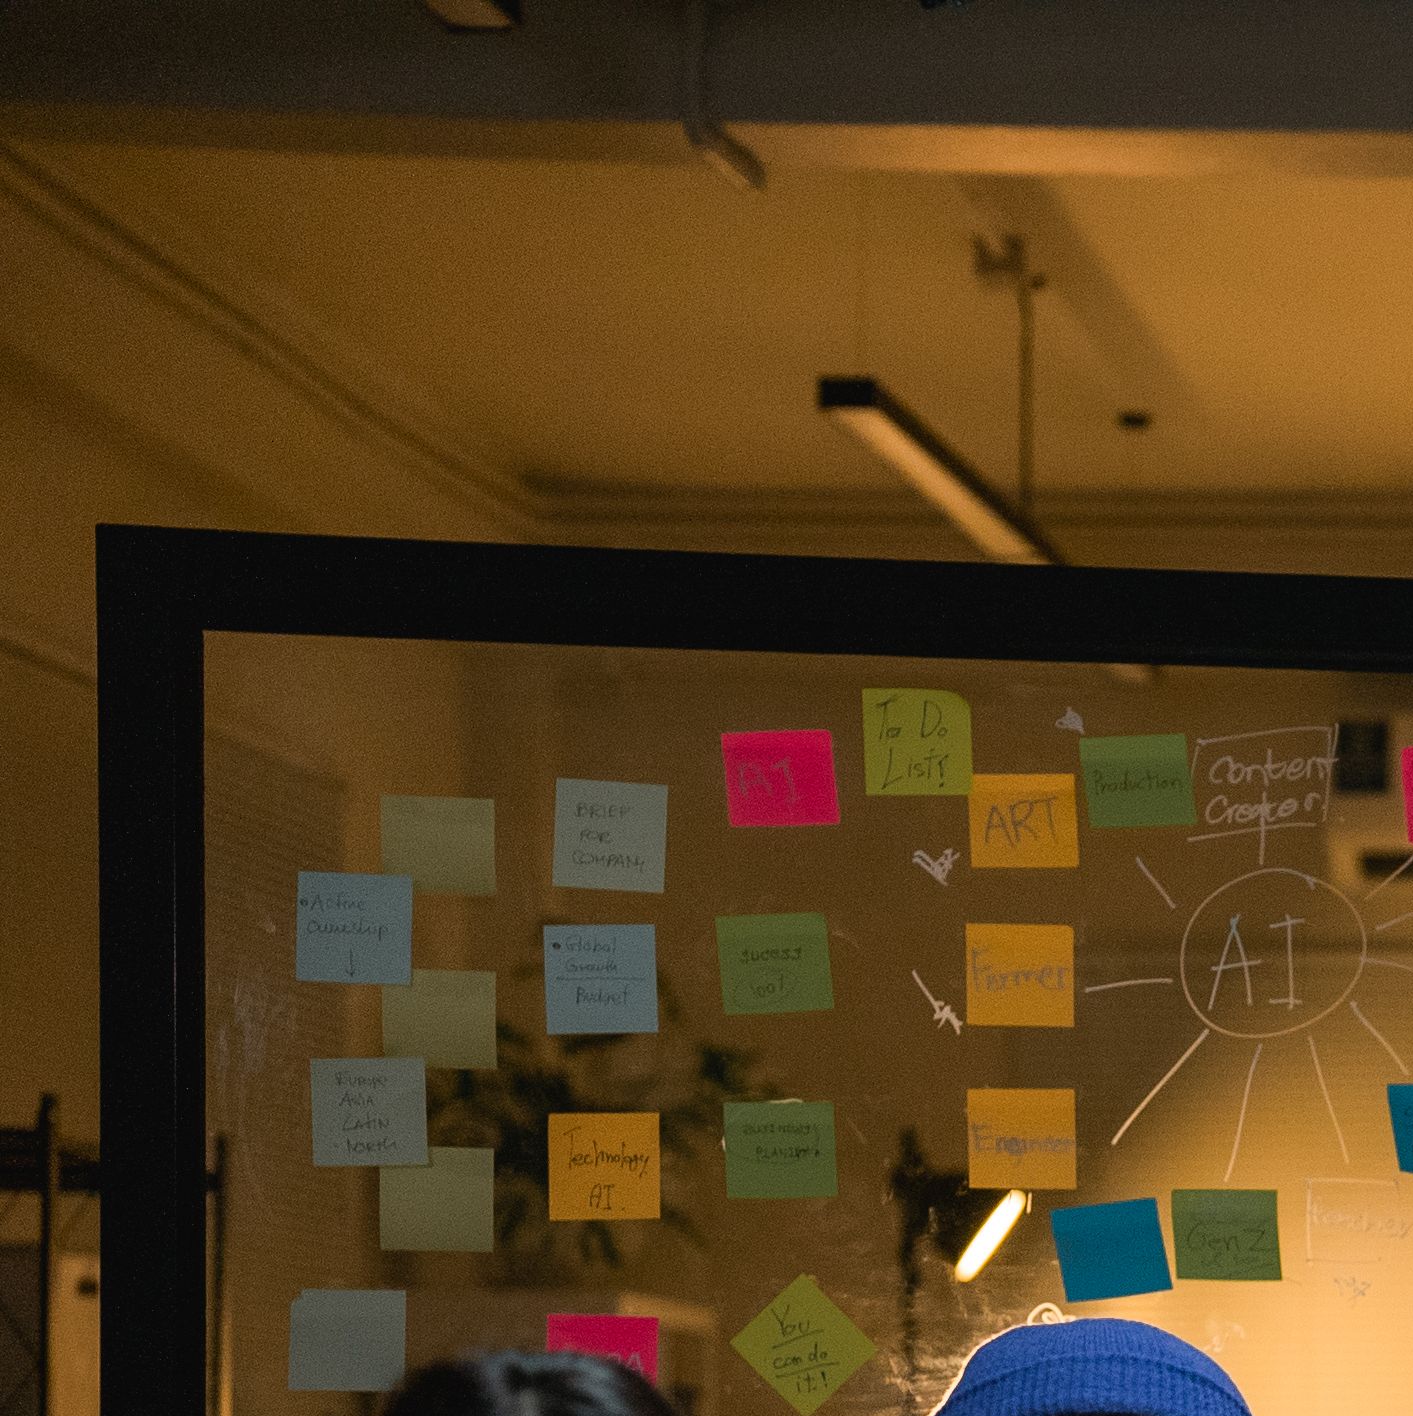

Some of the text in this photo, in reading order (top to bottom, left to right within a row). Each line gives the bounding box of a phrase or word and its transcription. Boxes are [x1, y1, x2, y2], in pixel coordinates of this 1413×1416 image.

[983, 795, 1058, 849] ART
[1207, 912, 1306, 1012] AI
[771, 1303, 812, 1338] You
